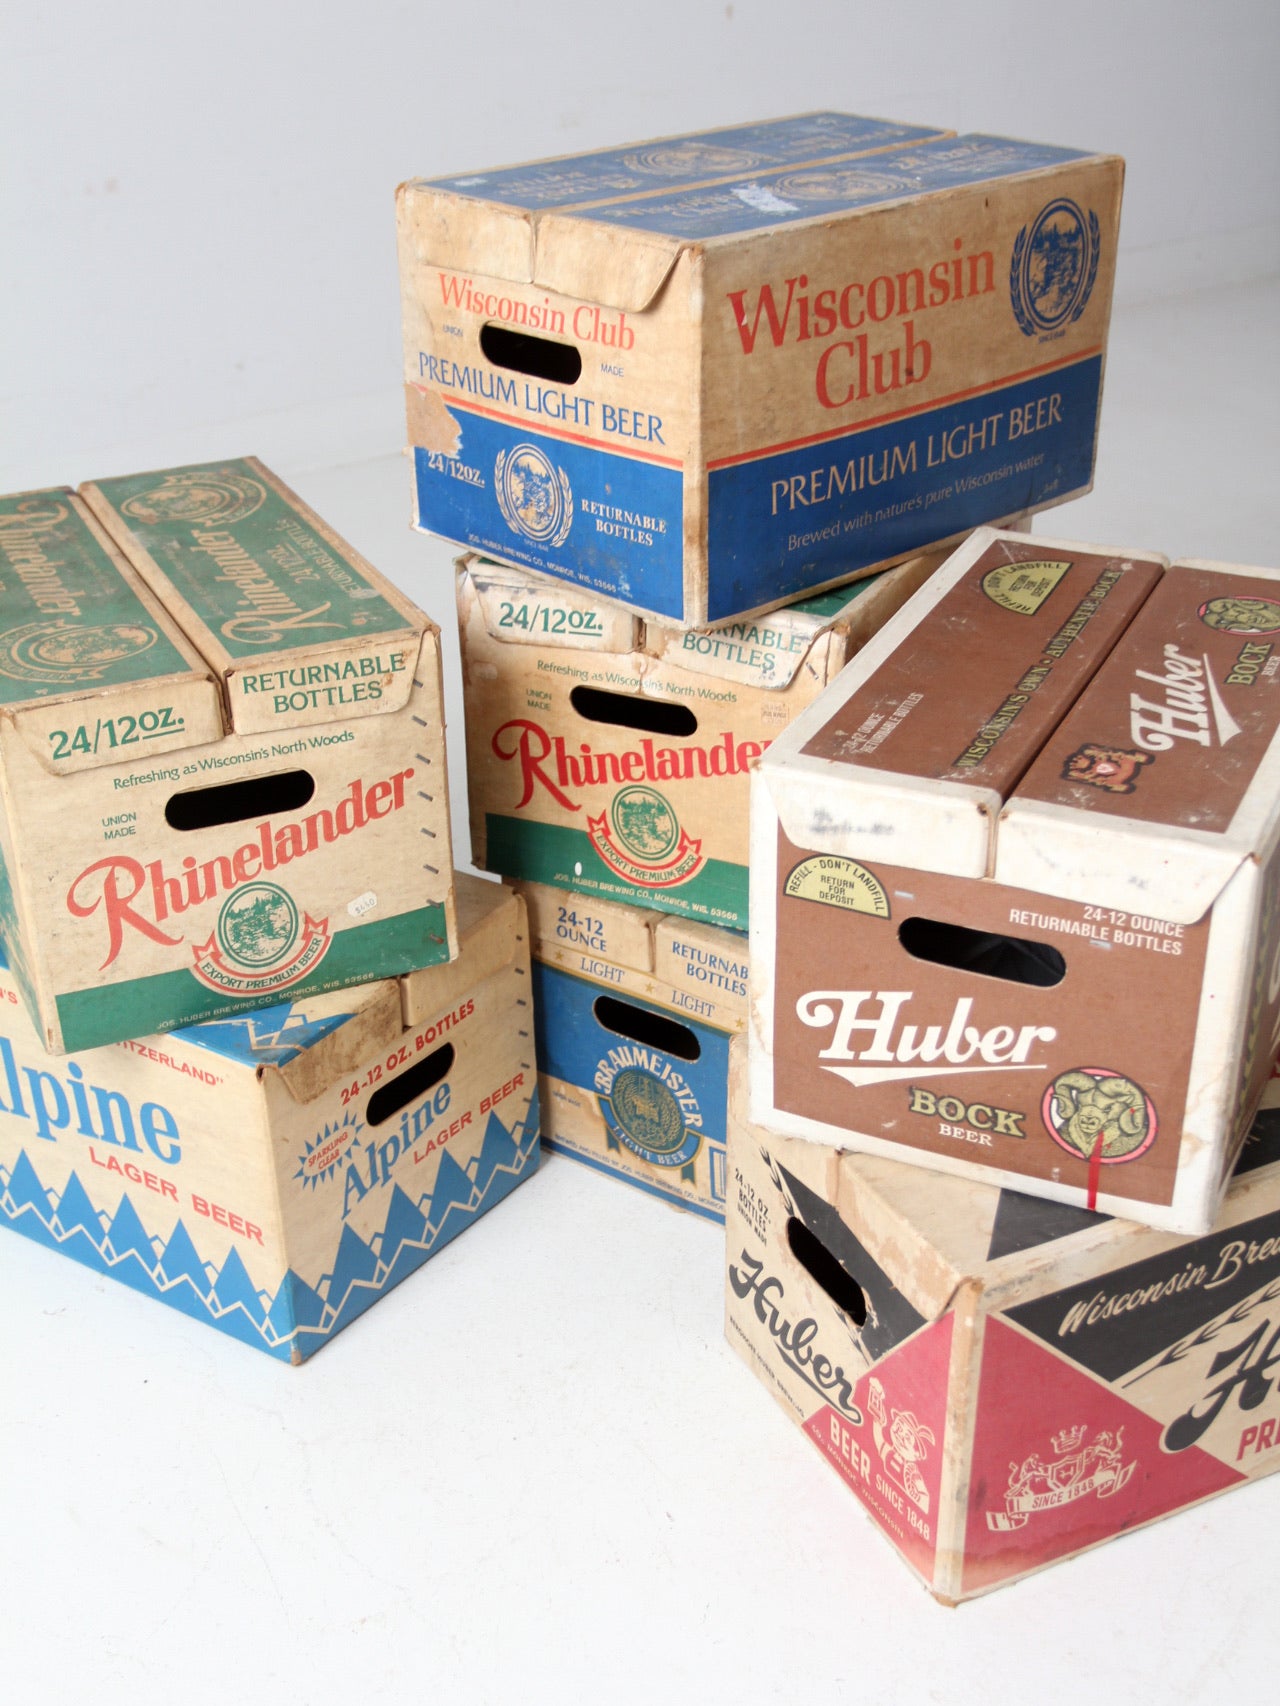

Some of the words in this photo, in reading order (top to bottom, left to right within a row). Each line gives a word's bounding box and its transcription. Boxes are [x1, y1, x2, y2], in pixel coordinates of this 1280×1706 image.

[438, 273, 566, 335] Wisconsin
[572, 305, 636, 351] Club
[727, 237, 996, 356] Wisconsin
[600, 363, 625, 377] MADE
[815, 320, 932, 409] Club
[419, 351, 518, 406] PREMIUM
[525, 383, 594, 426] LIGHT
[602, 404, 666, 445] BEER
[771, 440, 917, 516] PREMIUM
[926, 413, 1003, 469] LIGHT
[1008, 393, 1062, 441] BEER
[581, 499, 667, 533] RETURNABLE
[788, 522, 841, 552] Brewed
[843, 509, 873, 534] with
[874, 491, 923, 525] nature's
[924, 486, 953, 513] pure
[954, 463, 1014, 495] Wisconsin
[1014, 451, 1046, 475] water
[595, 518, 654, 546] BOTTLES
[190, 528, 347, 644] Rhinelander
[682, 633, 777, 671] BOTTLES
[1015, 664, 1053, 692] OWN
[1087, 568, 1125, 600] BOCK
[242, 652, 406, 694] RETURNABLE
[537, 659, 589, 682] Refreshing
[592, 671, 604, 681] as
[605, 671, 664, 694] Wisconsin's
[665, 681, 696, 699] North
[697, 687, 738, 703] Woods
[1225, 641, 1275, 686] BOCK
[273, 680, 384, 714] BOTTLES
[526, 687, 552, 701] UNION
[526, 699, 552, 712] MADE
[1130, 643, 1212, 752] Huber
[112, 765, 181, 791] Refreshing
[182, 763, 198, 776] as
[197, 746, 270, 772] Wisconsin's
[271, 739, 307, 759] North
[307, 729, 356, 751] Woods
[101, 811, 138, 829] UNION
[103, 825, 137, 841] MADE
[66, 767, 414, 971] Rhinelander
[596, 833, 629, 870] EXPORT
[628, 865, 677, 882] PREMIUM
[675, 853, 697, 876] BEER
[571, 874, 599, 889] HUBER
[598, 881, 636, 898] BREWING
[789, 865, 813, 893] REFILL
[818, 859, 852, 872] DON'T
[852, 867, 886, 912] LANDFILL
[819, 890, 855, 906] DEPOSIT
[820, 874, 855, 890] RETURN
[828, 884, 846, 896] FOR
[556, 924, 607, 952] OUNCE
[557, 906, 604, 937] 24-12
[1008, 908, 1111, 941] RETURNABLE
[1112, 928, 1183, 956] BOTTLES
[1083, 905, 1127, 927] 24-12
[1129, 915, 1186, 939] OUNCE
[200, 958, 246, 991] EXPORT
[245, 962, 301, 990] PREMIUM
[297, 935, 324, 967] BEER
[672, 940, 749, 980] RETURNAB
[686, 963, 747, 996] BOTTLES
[157, 1018, 179, 1031] JOS.
[212, 999, 257, 1018] BREWING
[322, 977, 342, 989] WIS.
[580, 956, 626, 984] LIGHT
[671, 989, 716, 1018] LIGHT
[795, 989, 1057, 1064] Huber
[340, 1064, 384, 1107] 24-12
[385, 1046, 412, 1072] OZ.
[415, 998, 475, 1052] BOTTLES
[0, 1036, 182, 1165] lpine
[594, 1046, 704, 1129] BRAUMEISTER
[413, 1111, 472, 1165] LAGER
[479, 1072, 525, 1115] BEER
[908, 1085, 1027, 1139] BOCK
[938, 1122, 994, 1147] BEER
[307, 1131, 349, 1168] SPARKLING
[318, 1149, 341, 1171] CLEAR
[341, 1082, 451, 1221] Alpine
[613, 1125, 655, 1165] LIGHT
[657, 1149, 688, 1166] BEER
[89, 1145, 180, 1203] LAGER
[191, 1193, 265, 1248] BEER
[735, 1167, 756, 1200] 24-12
[757, 1198, 772, 1225] OZ.
[738, 1187, 767, 1234] BOTTLES
[1058, 1262, 1208, 1338] Wisconsin
[729, 1248, 860, 1422] Huber
[829, 1414, 872, 1485] BEER
[875, 1474, 905, 1516] SINCE
[906, 1504, 931, 1541] 1848
[1031, 1490, 1065, 1510] SINCE
[1066, 1478, 1096, 1500] 1848
